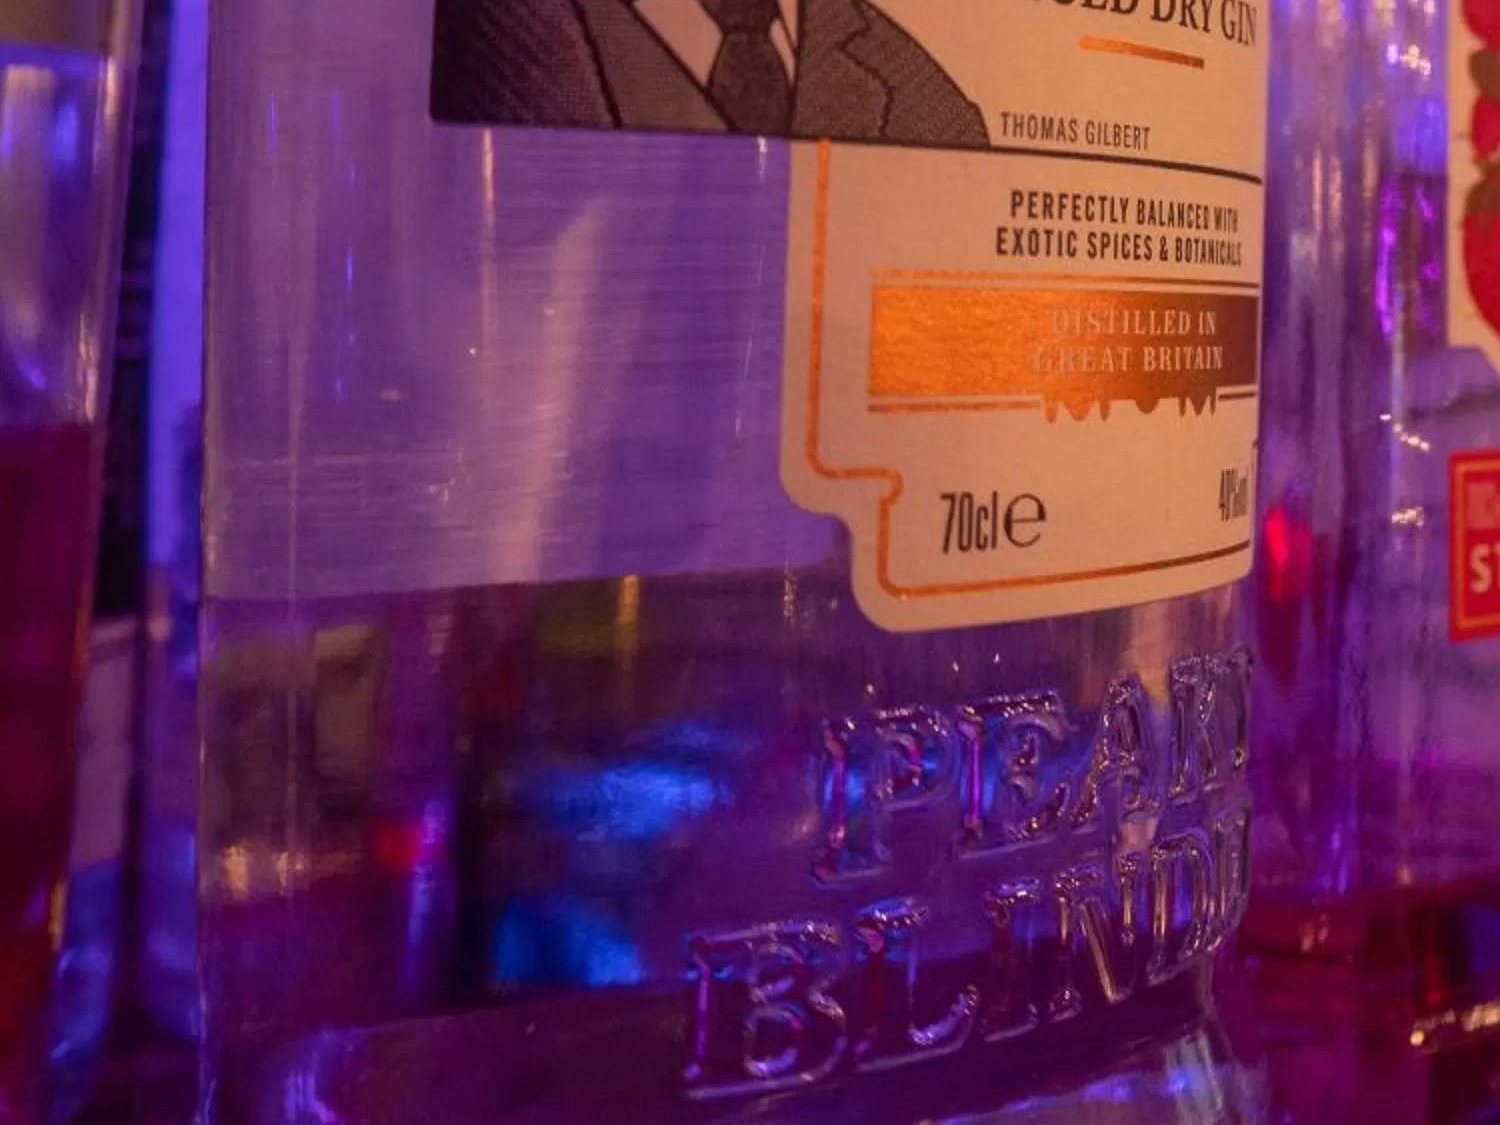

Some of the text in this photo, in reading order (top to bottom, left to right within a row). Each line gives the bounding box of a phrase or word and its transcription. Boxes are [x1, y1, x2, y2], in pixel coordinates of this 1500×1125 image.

[1001, 111, 1151, 152] THOMAS GILBERT
[1010, 190, 1239, 235] PERFECTLY BALANCED WITH
[995, 226, 1243, 267] EXOTIC SPICES & BOTANICALS
[1049, 305, 1217, 336] DISTILLED IN
[1031, 345, 1223, 373] GREAT BRITAIN
